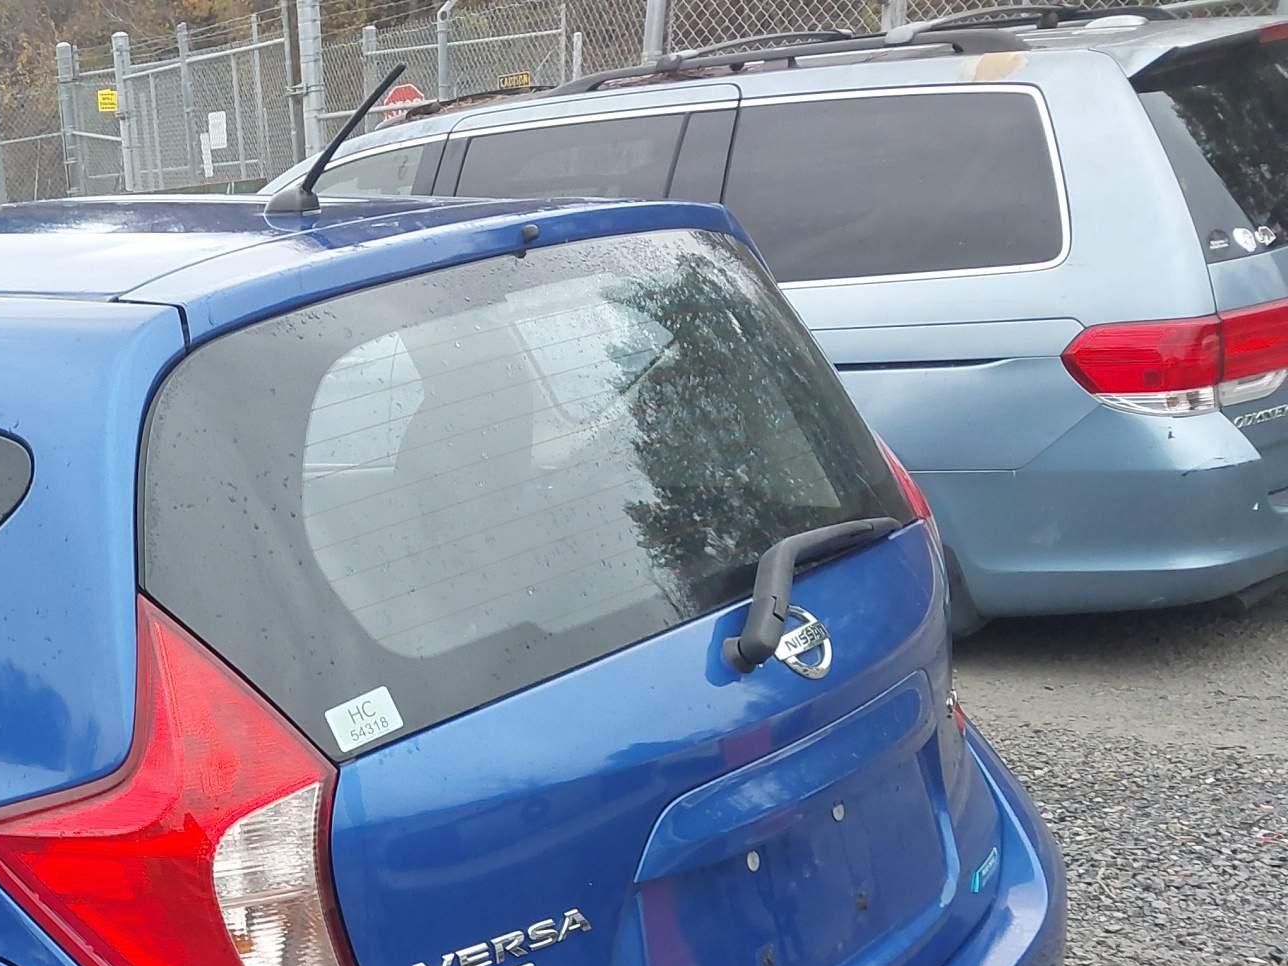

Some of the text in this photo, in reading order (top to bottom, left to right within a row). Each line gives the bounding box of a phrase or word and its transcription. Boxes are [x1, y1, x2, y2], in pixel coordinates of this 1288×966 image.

[1233, 404, 1288, 428] ODYSSE
[784, 623, 827, 652] NISSAN
[347, 700, 377, 725] HC
[350, 716, 389, 742] 54318
